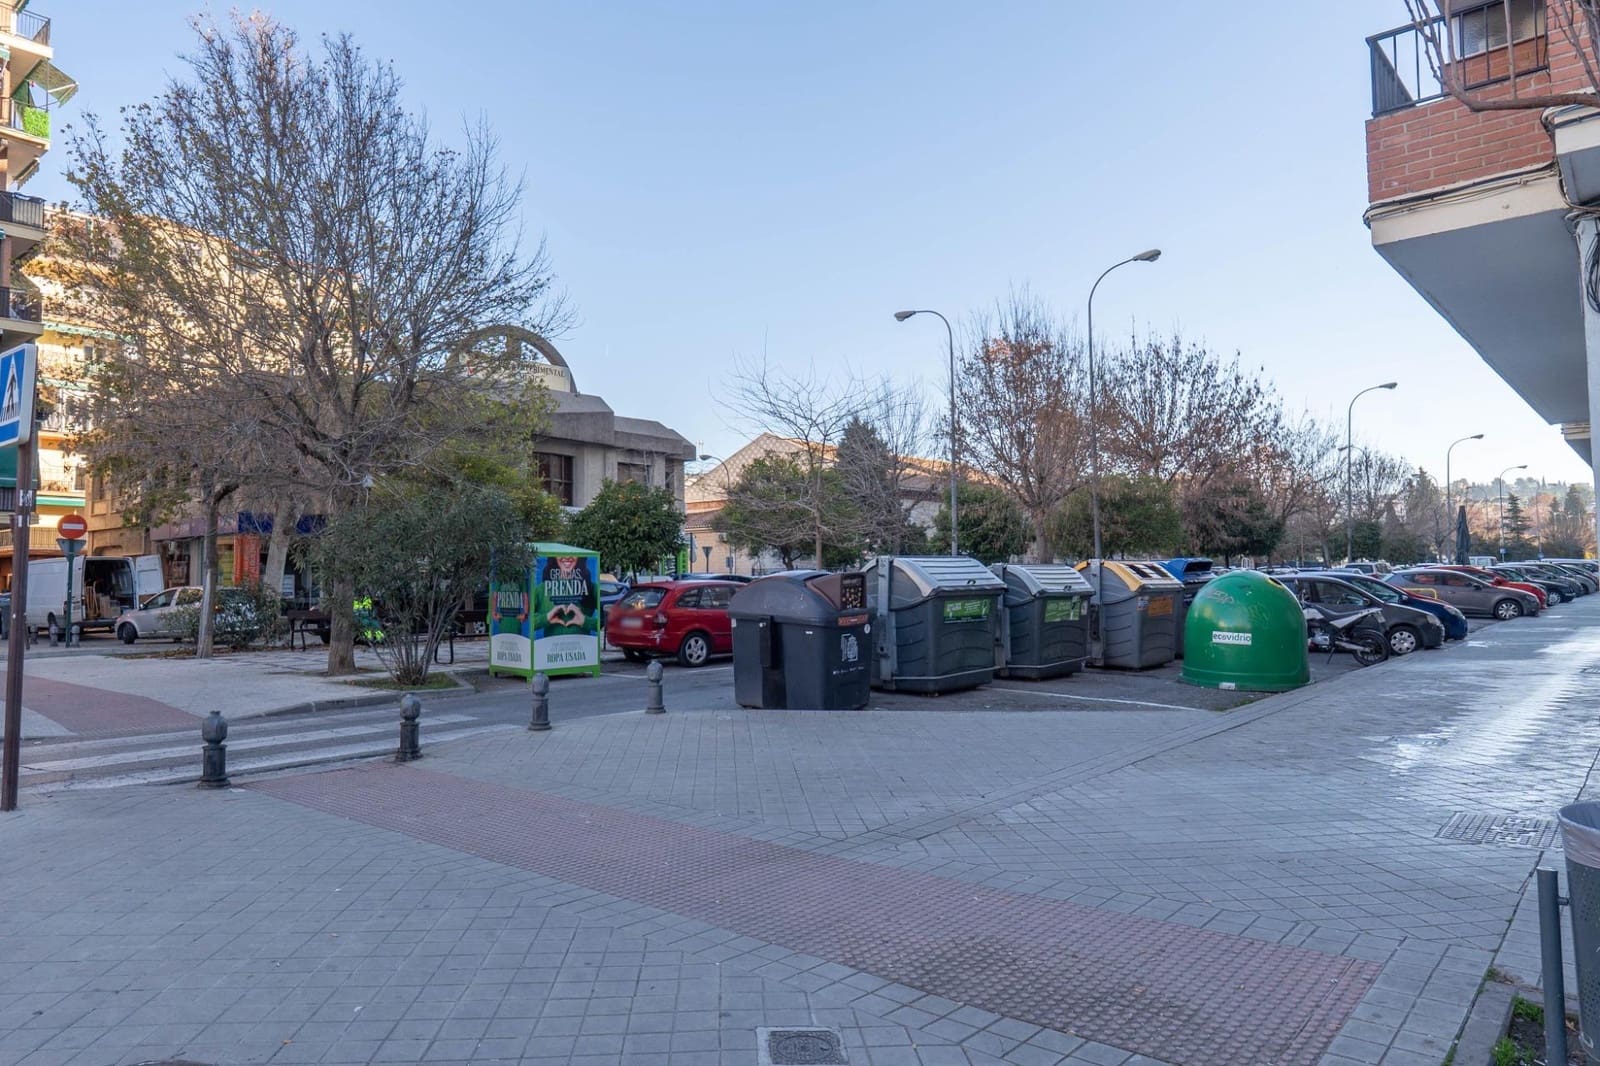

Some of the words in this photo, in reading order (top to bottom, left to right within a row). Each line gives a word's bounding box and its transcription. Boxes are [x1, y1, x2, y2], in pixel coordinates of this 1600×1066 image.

[544, 579, 589, 597] PRENDA
[497, 591, 524, 608] PRENDA
[1213, 632, 1251, 642] ecovidrio
[547, 652, 564, 663] ROPA
[565, 650, 586, 663] USADA
